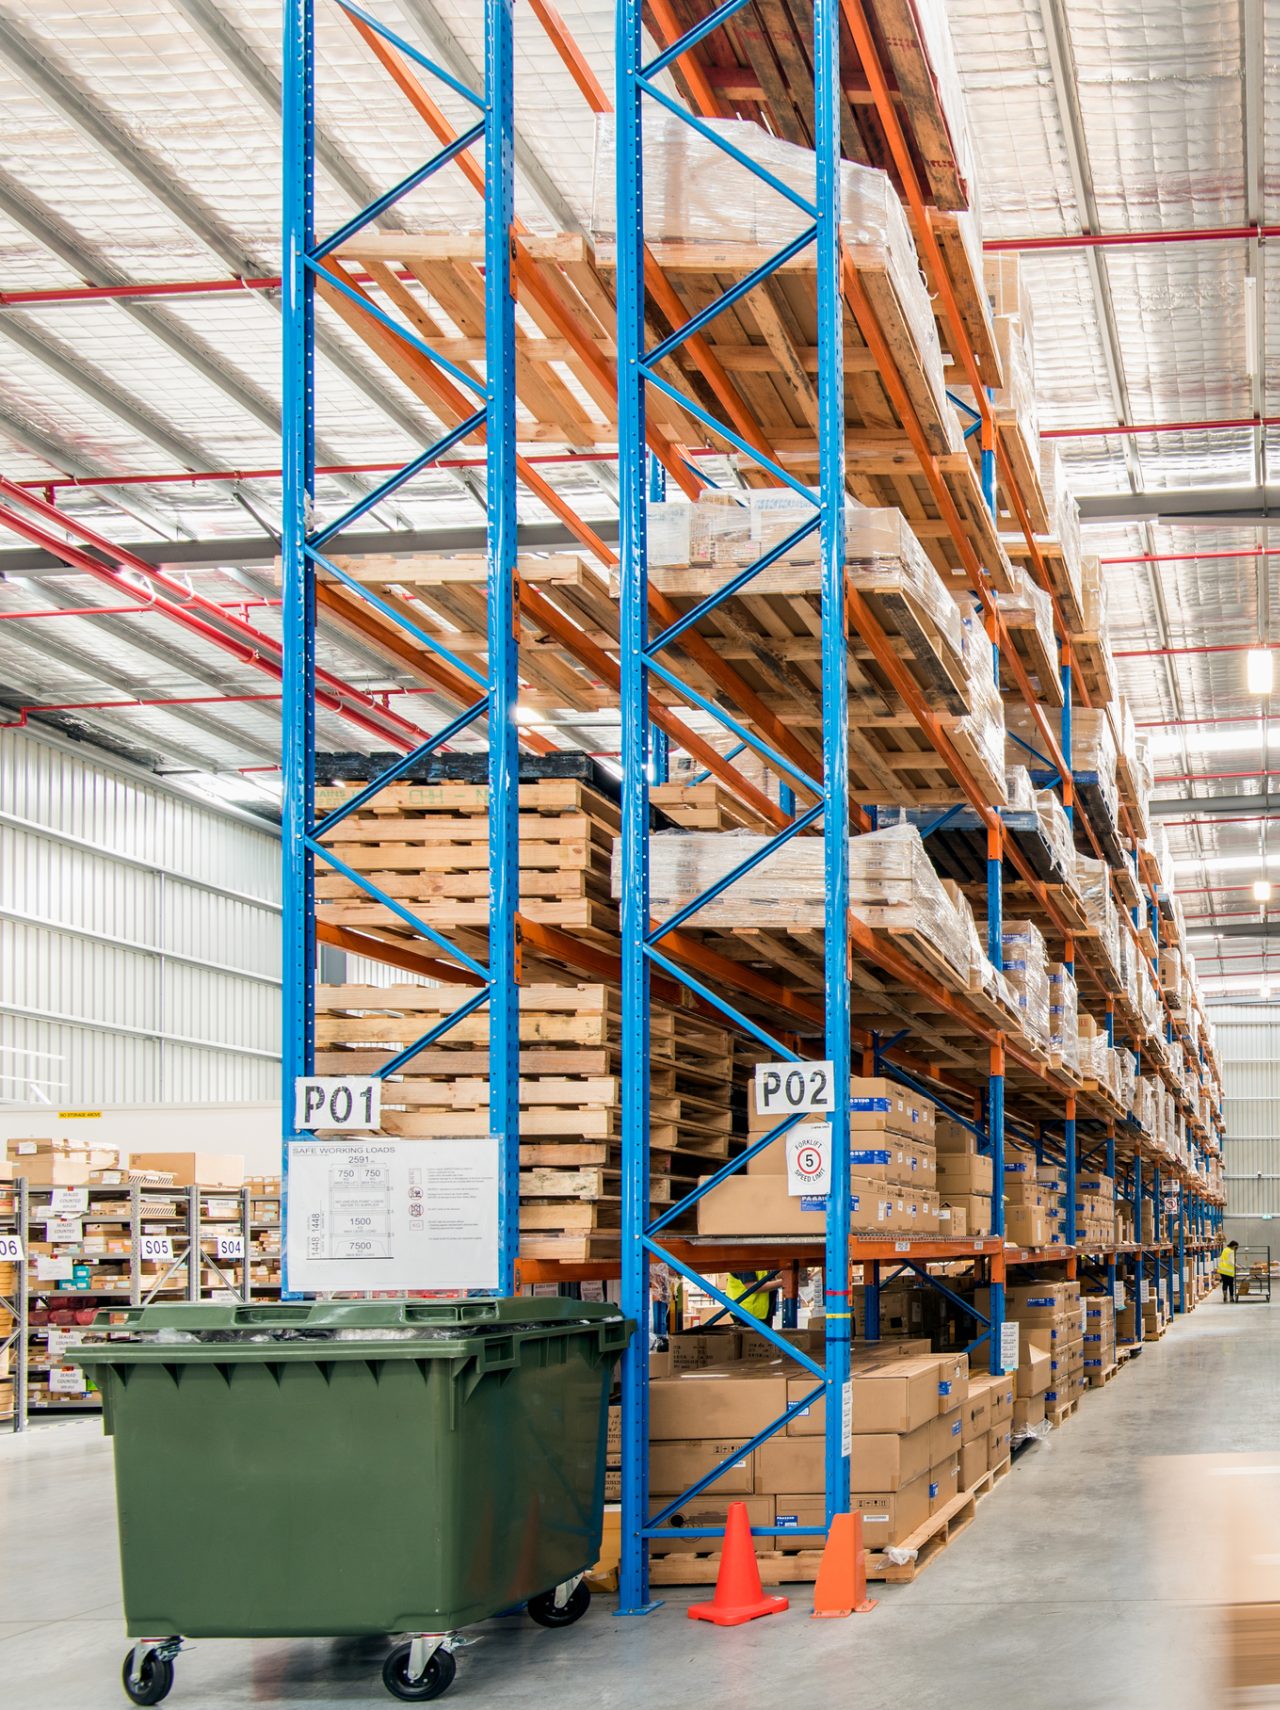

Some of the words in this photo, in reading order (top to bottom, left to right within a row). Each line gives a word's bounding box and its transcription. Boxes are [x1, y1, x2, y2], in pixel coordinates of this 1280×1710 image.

[763, 1069, 828, 1107] P02
[304, 1086, 373, 1123] P01
[366, 1146, 396, 1154] LOADS
[794, 1140, 822, 1150] FORKLIFT
[348, 1156, 369, 1164] 2591
[805, 1154, 814, 1167] 5
[364, 1169, 380, 1177] 750
[794, 1169, 811, 1182] SPEED
[812, 1168, 825, 1181] LIMIT
[350, 1217, 371, 1225] 1500
[145, 1240, 169, 1254] S05
[221, 1240, 241, 1254] S04
[349, 1242, 371, 1250] 7500
